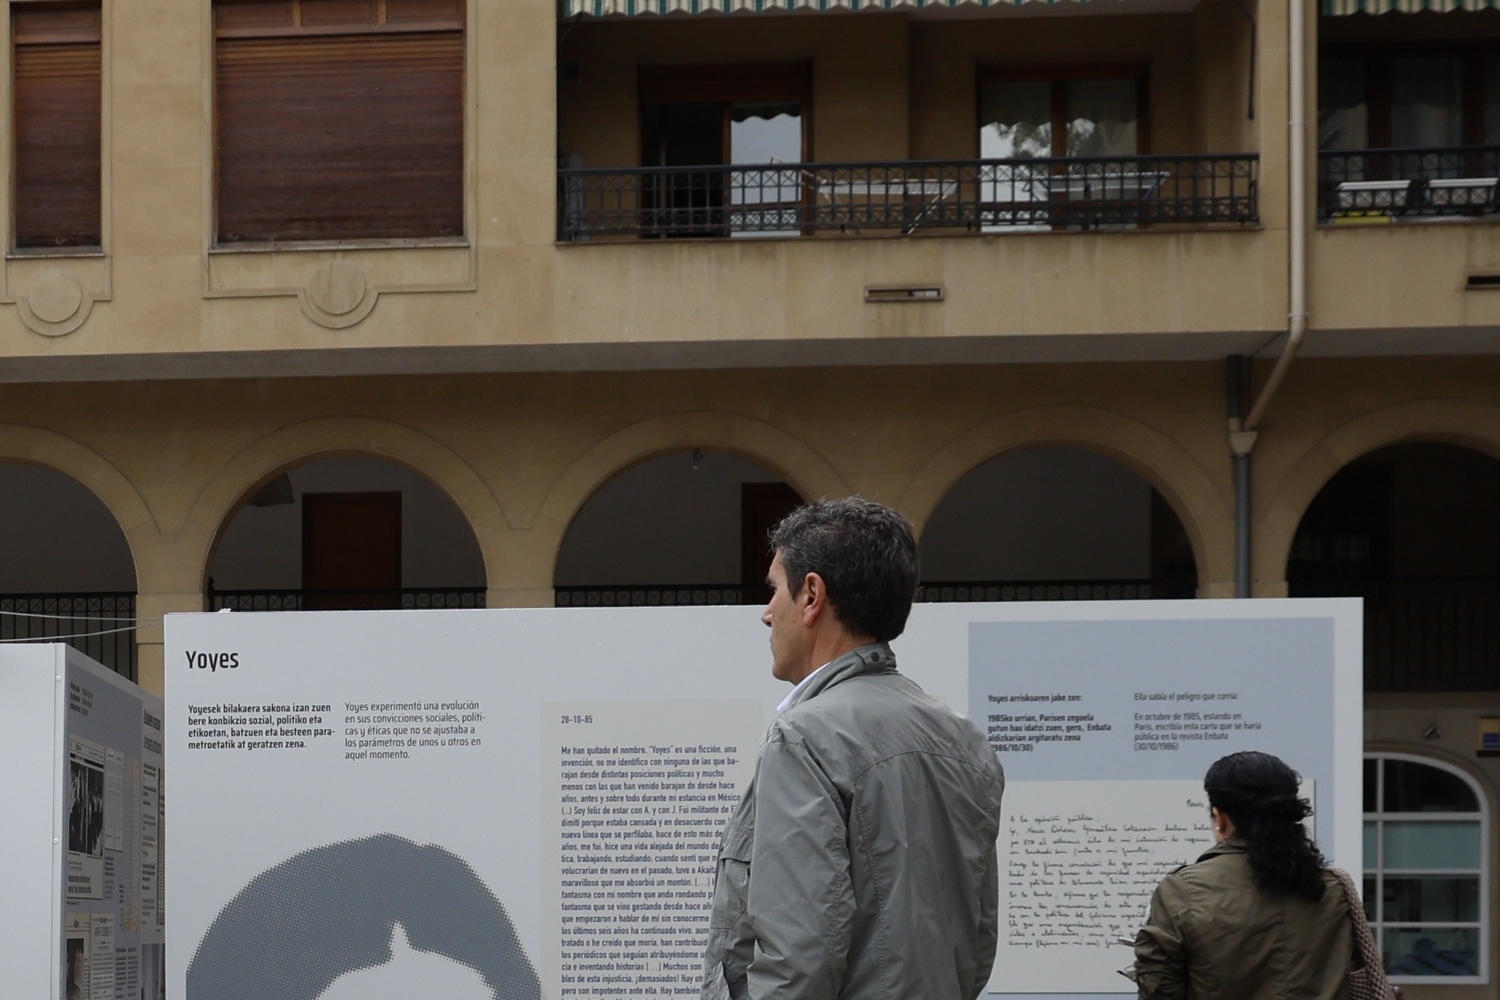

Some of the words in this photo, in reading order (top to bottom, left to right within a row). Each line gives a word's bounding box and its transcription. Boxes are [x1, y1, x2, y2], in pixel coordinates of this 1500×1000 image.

[185, 651, 239, 672] Yoyes
[188, 704, 221, 715] Yoyesek
[223, 703, 260, 713] bilakaera
[262, 703, 291, 713] sakona
[292, 703, 309, 712] izan
[345, 702, 369, 713] Yoyes
[370, 701, 422, 712] experimentó
[441, 700, 479, 710] evolución
[188, 715, 206, 725] bere
[208, 716, 247, 725] konbikzio
[248, 715, 275, 726] sozial,
[276, 715, 307, 726] politiko
[309, 715, 322, 724] eta
[373, 713, 424, 723] convicciones
[425, 713, 460, 723] sociales,
[561, 715, 593, 724] 28-10-85
[188, 728, 229, 738] etikoetan,
[231, 727, 263, 737] batzuen
[265, 728, 278, 736] eta
[280, 727, 312, 736] besteen
[314, 729, 335, 738] para-
[367, 725, 391, 735] éticas
[393, 727, 408, 736] que
[410, 727, 421, 735] no
[433, 724, 468, 736] ajustaba
[188, 739, 236, 749] metroetatik
[247, 740, 283, 750] geratzen
[345, 738, 357, 747] los
[359, 738, 405, 749] parámetros
[419, 739, 439, 747] unos
[448, 737, 469, 746] otros
[345, 750, 367, 761] aquel
[369, 750, 410, 759] momento.
[573, 746, 585, 755] han
[587, 746, 611, 756] quitado
